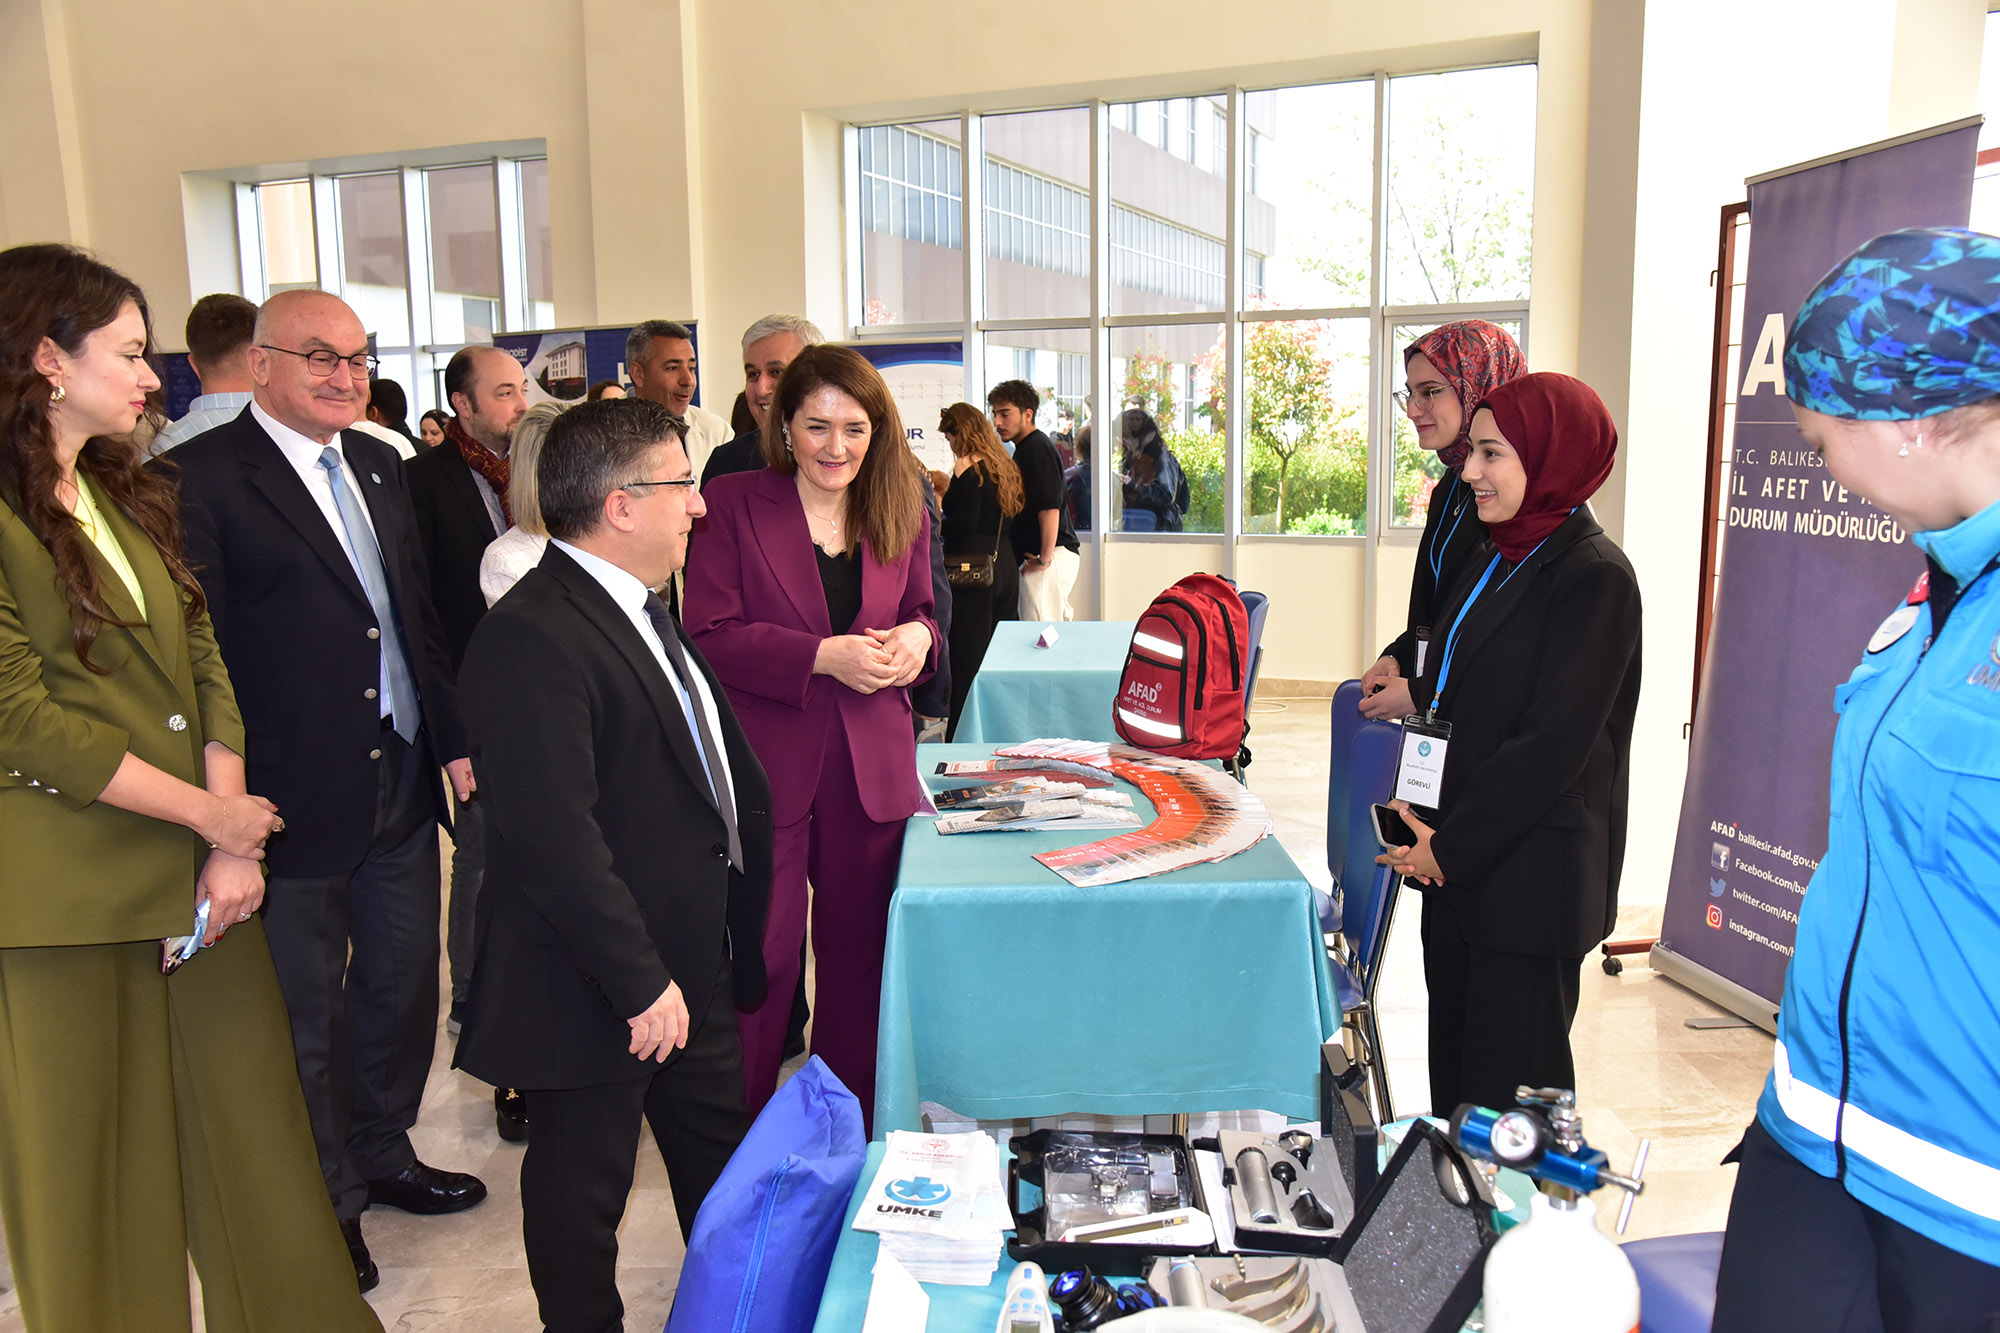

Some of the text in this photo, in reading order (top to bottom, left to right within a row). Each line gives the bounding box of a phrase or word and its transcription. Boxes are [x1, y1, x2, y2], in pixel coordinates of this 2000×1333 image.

[1735, 449, 1759, 465] T.C.
[1732, 471, 1748, 496] İL
[1761, 476, 1809, 500] AFET
[1822, 480, 1849, 503] VE
[1729, 506, 1788, 532] DURUM
[1128, 680, 1157, 703] AFAD
[1710, 820, 1735, 838] AFAD
[876, 1204, 943, 1219] UMKE
